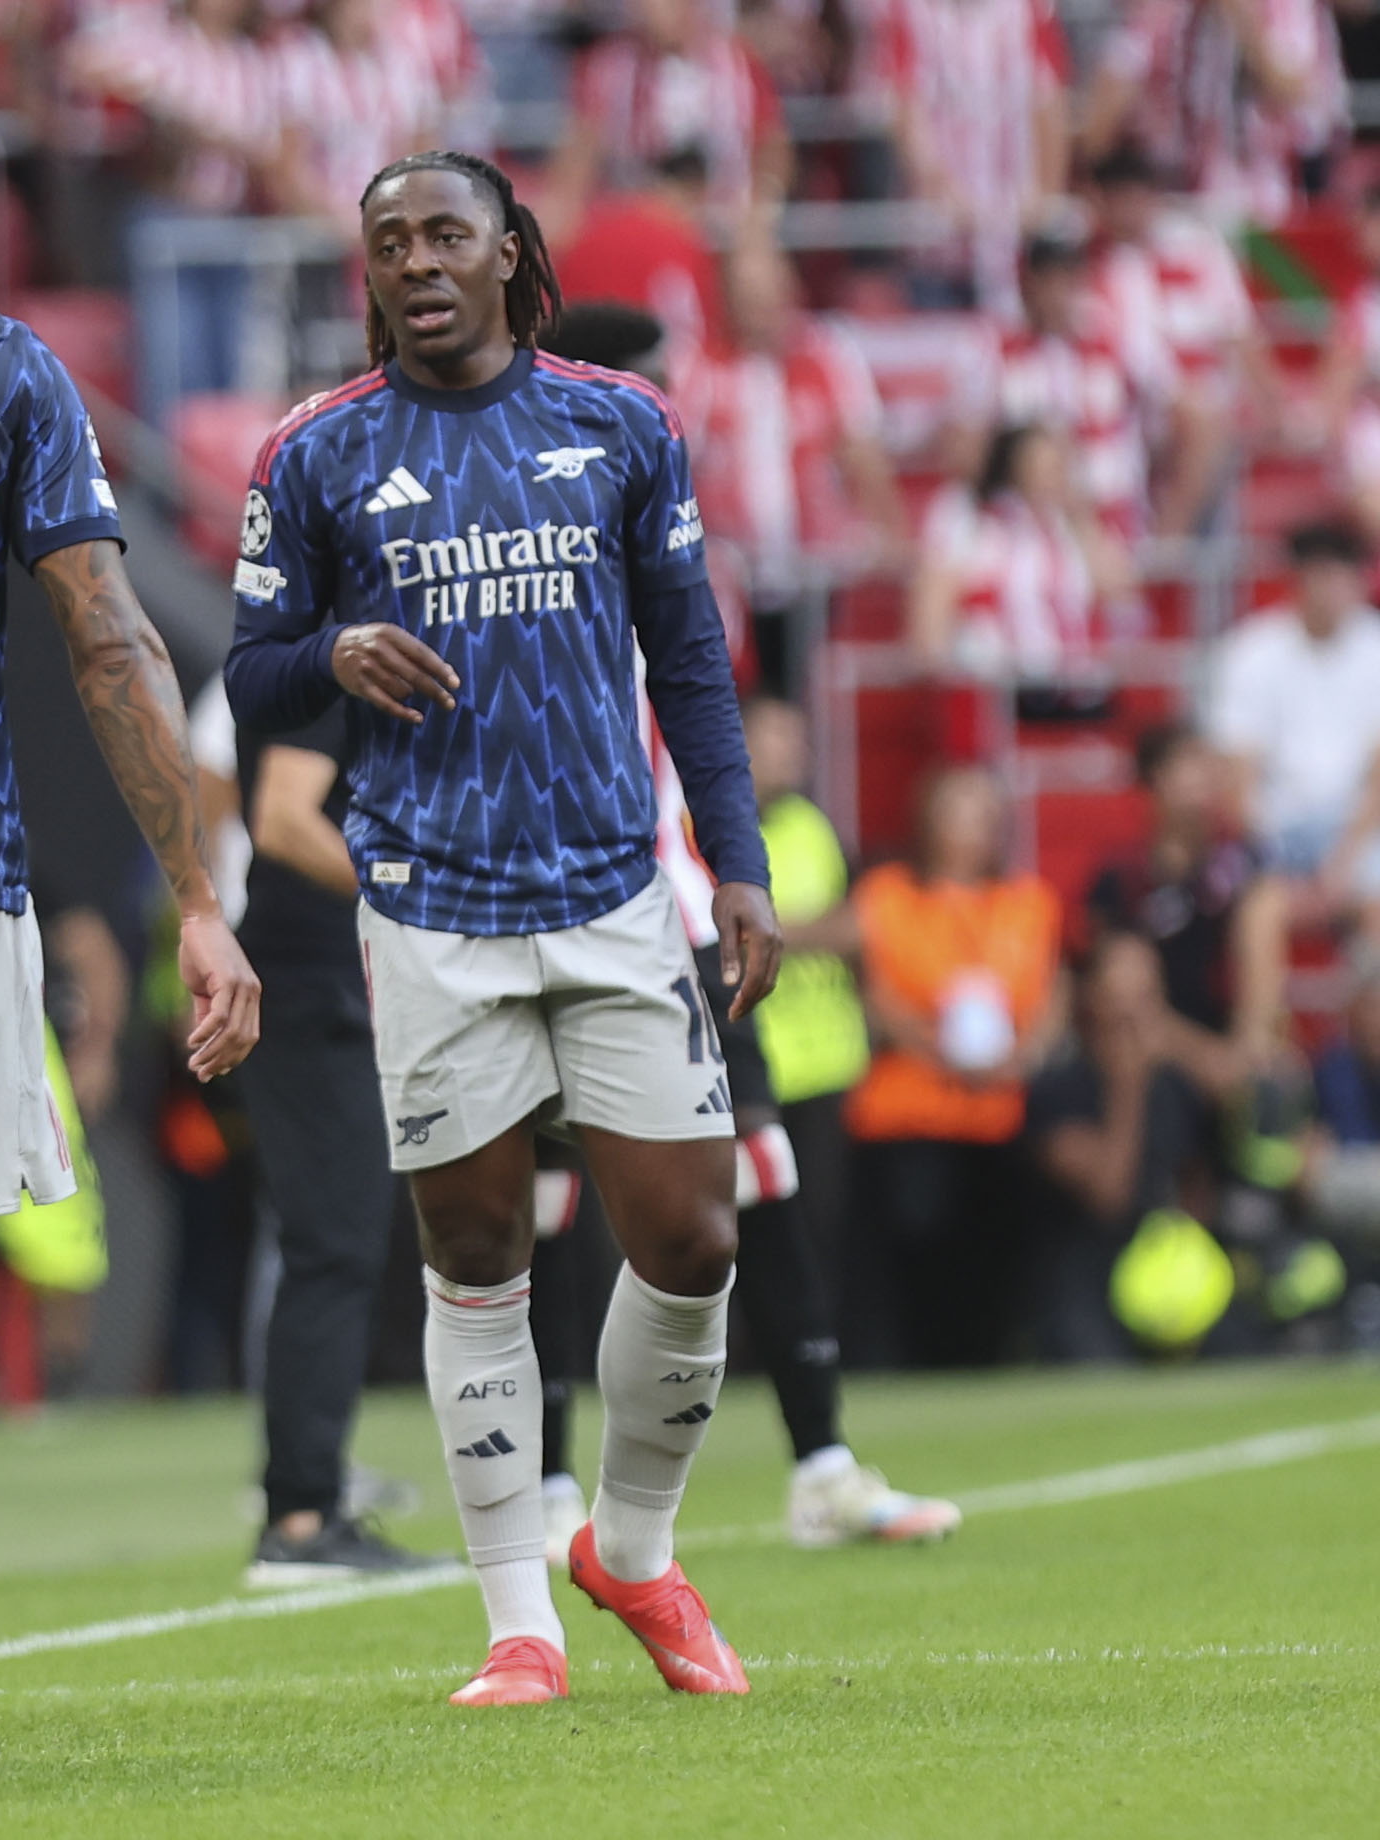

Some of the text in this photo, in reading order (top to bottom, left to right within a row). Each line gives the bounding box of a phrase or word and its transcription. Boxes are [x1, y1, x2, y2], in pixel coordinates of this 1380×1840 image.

[381, 518, 599, 588] Emirates
[424, 570, 577, 627] FLY BETTER
[458, 1379, 517, 1400] AFC
